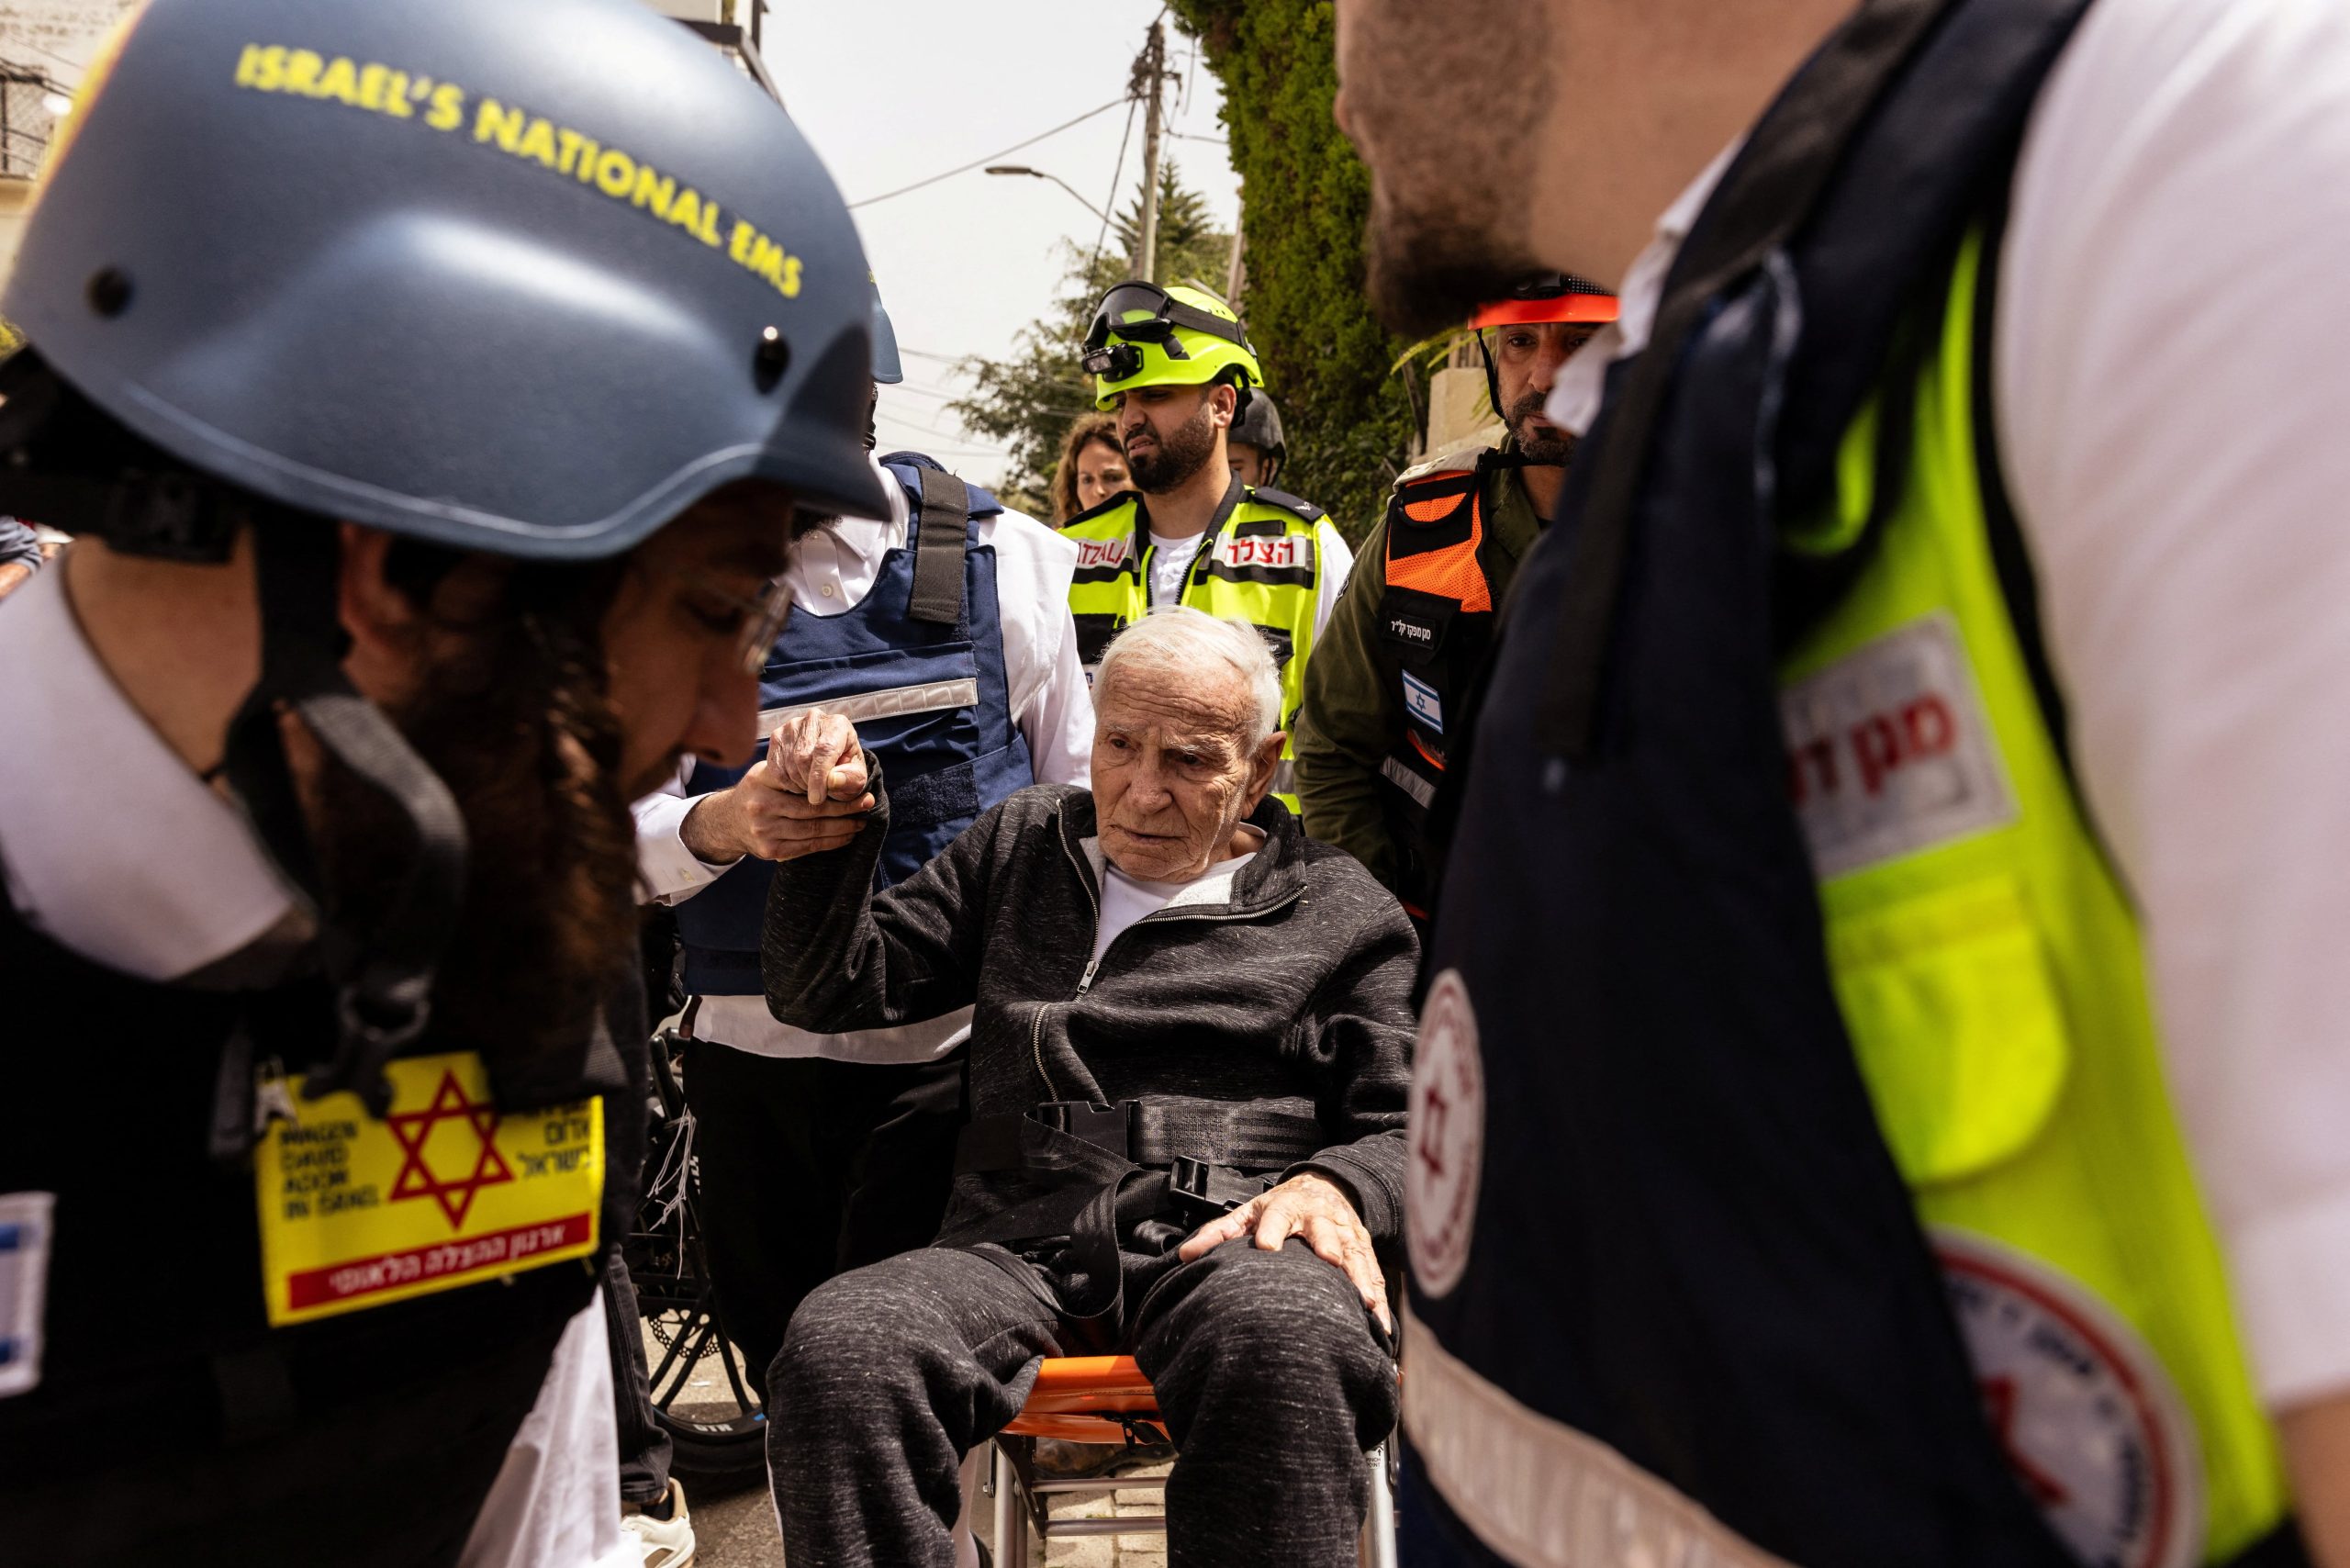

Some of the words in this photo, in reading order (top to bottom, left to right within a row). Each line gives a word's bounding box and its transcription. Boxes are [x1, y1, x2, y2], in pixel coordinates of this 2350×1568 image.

[236, 43, 464, 131] ISRAEL'S
[474, 97, 722, 248] NATIONAL
[729, 219, 803, 298] EMS
